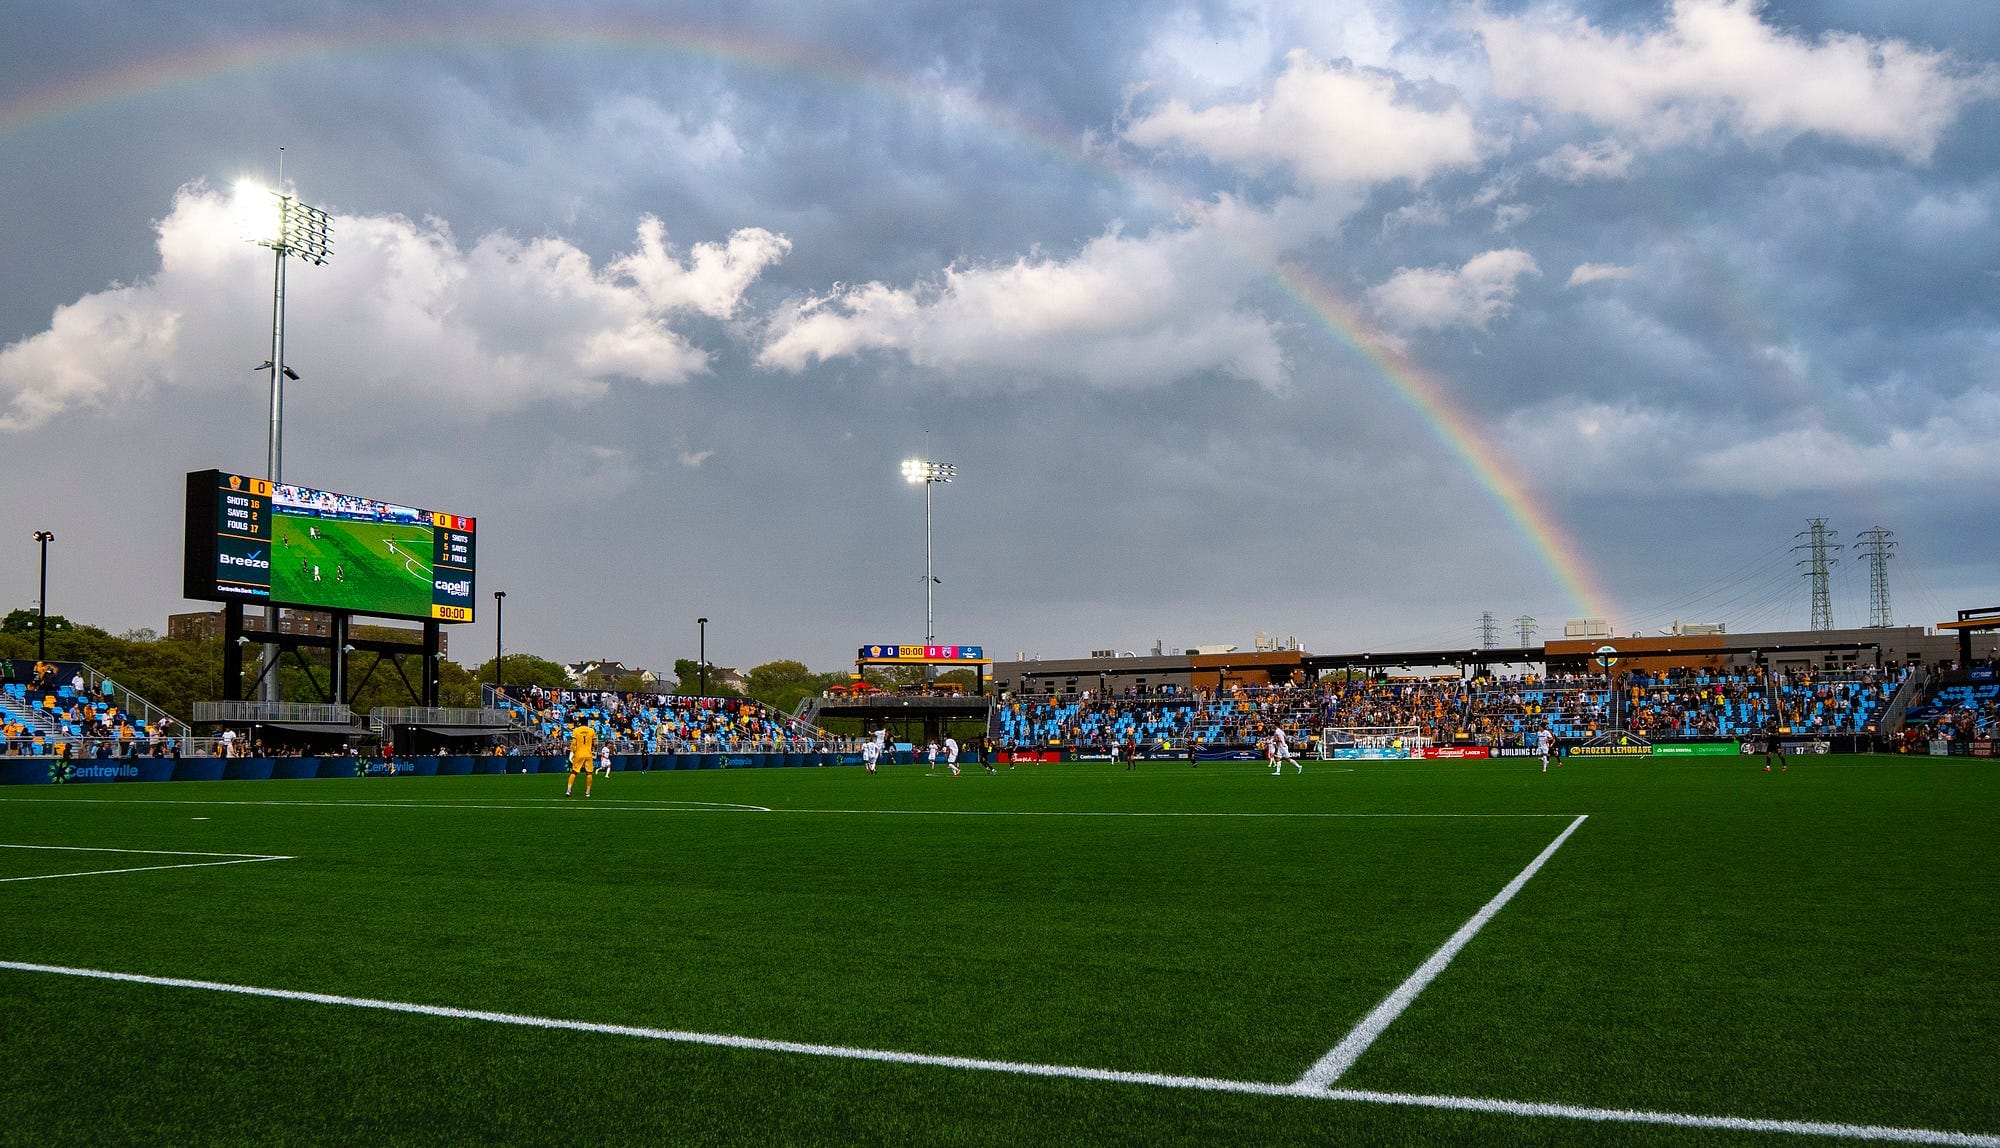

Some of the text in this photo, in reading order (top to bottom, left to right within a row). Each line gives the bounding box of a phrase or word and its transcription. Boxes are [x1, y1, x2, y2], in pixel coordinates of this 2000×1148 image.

[258, 482, 265, 494] 0
[227, 496, 260, 508] SHOTS 16
[228, 508, 258, 520] SAVES 2
[228, 520, 258, 533] FOULS 17
[440, 515, 446, 526] 0
[220, 554, 269, 569] Breeze
[452, 555, 467, 563] FOULS
[435, 580, 470, 594] capelli
[440, 606, 464, 619] 90:00
[888, 647, 893, 656] 0
[930, 648, 936, 656] 0
[66, 764, 138, 777] Centreville
